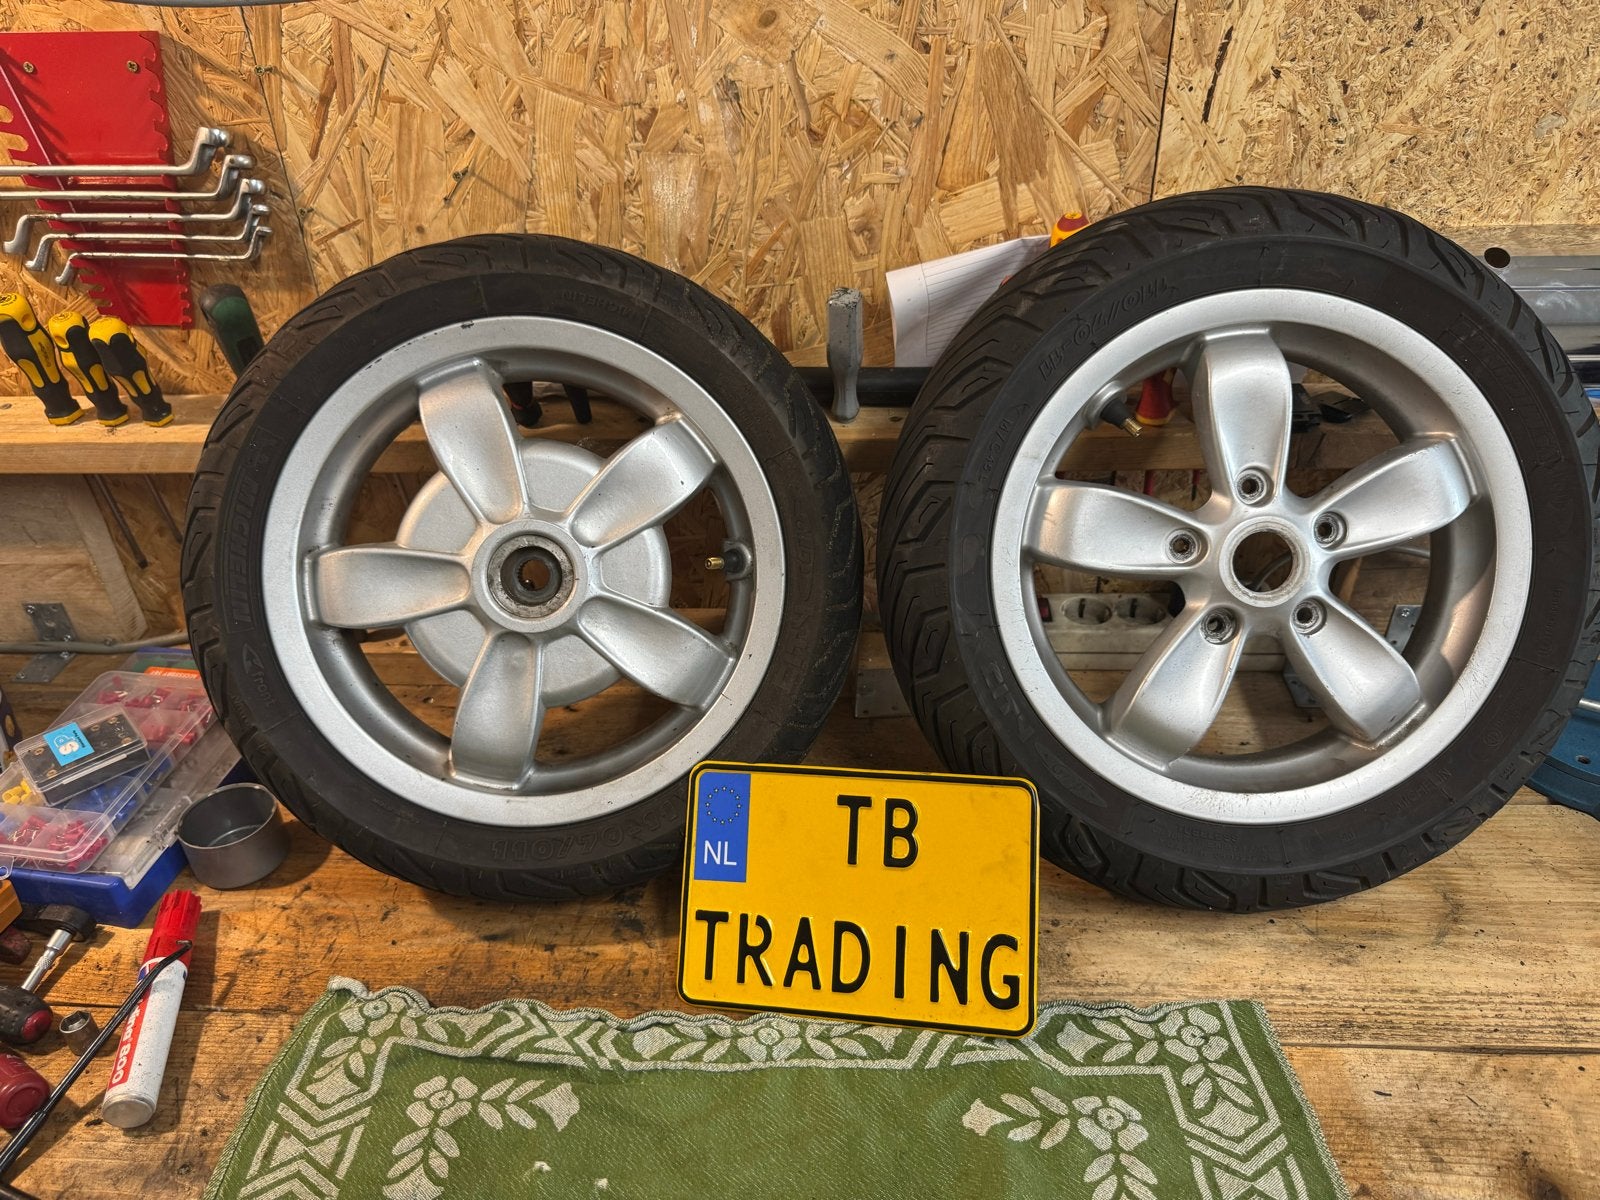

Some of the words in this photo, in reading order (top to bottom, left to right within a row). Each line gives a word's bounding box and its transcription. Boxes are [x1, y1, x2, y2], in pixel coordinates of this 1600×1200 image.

[226, 474, 261, 624] MICHELIN
[251, 669, 277, 707] front
[703, 840, 737, 866] NL
[836, 794, 920, 868] TB
[694, 909, 1023, 1010] TRADING
[111, 1042, 132, 1085] 800
